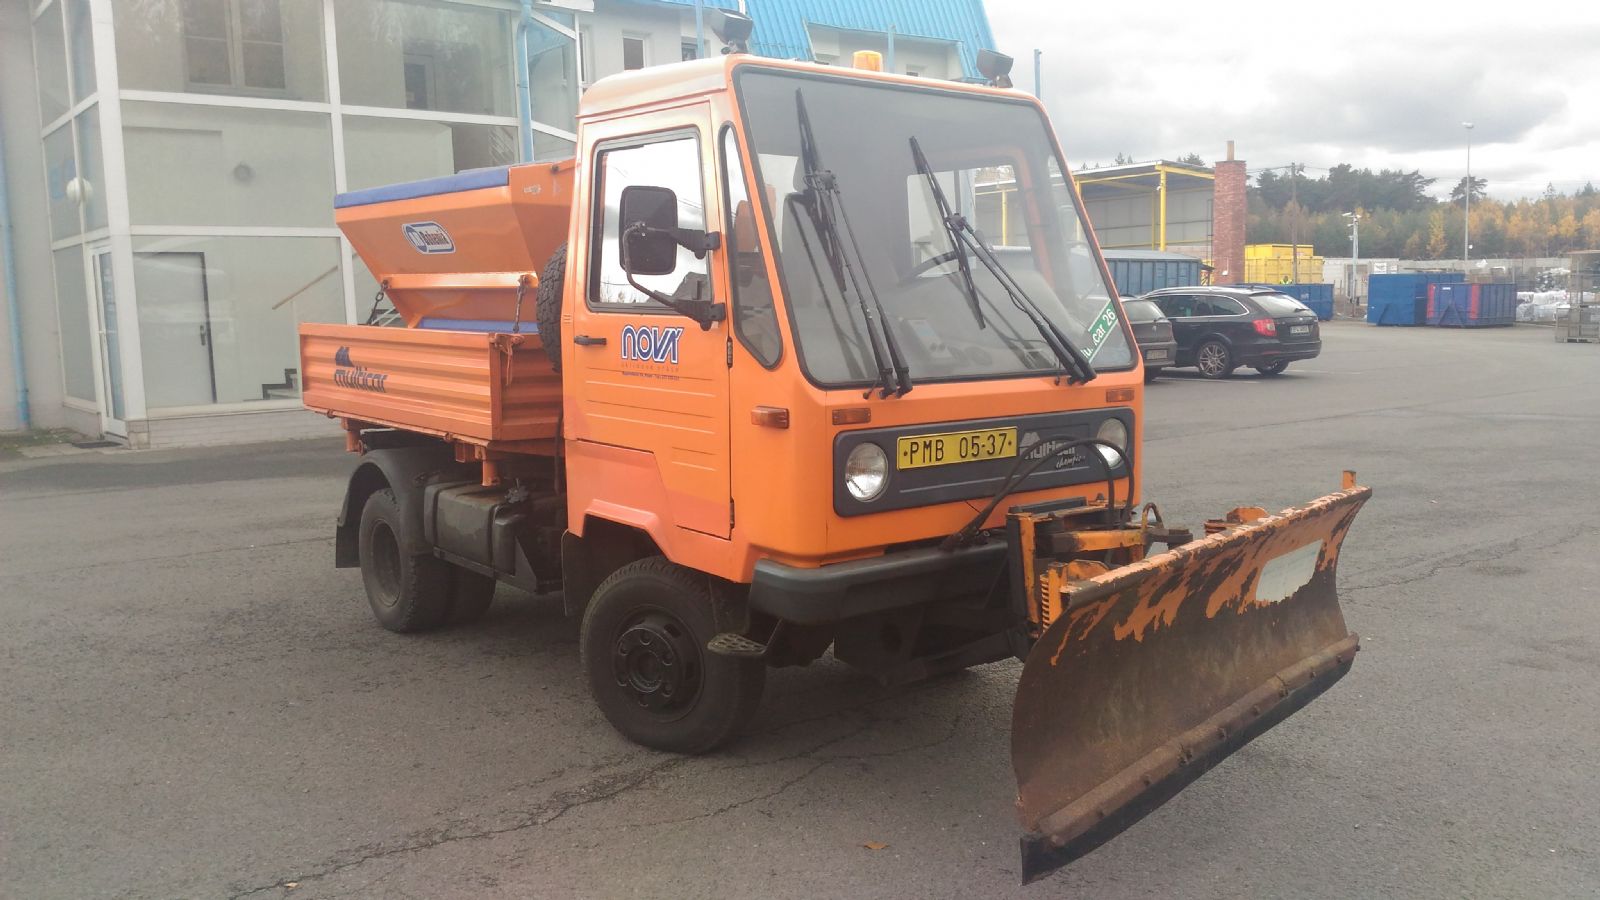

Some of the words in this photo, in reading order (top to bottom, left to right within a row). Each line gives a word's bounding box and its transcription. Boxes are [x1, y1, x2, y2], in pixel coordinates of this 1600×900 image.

[1102, 308, 1116, 326] 26
[335, 365, 388, 393] multicar
[910, 439, 944, 465] PMB
[959, 433, 1007, 458] 05-37
